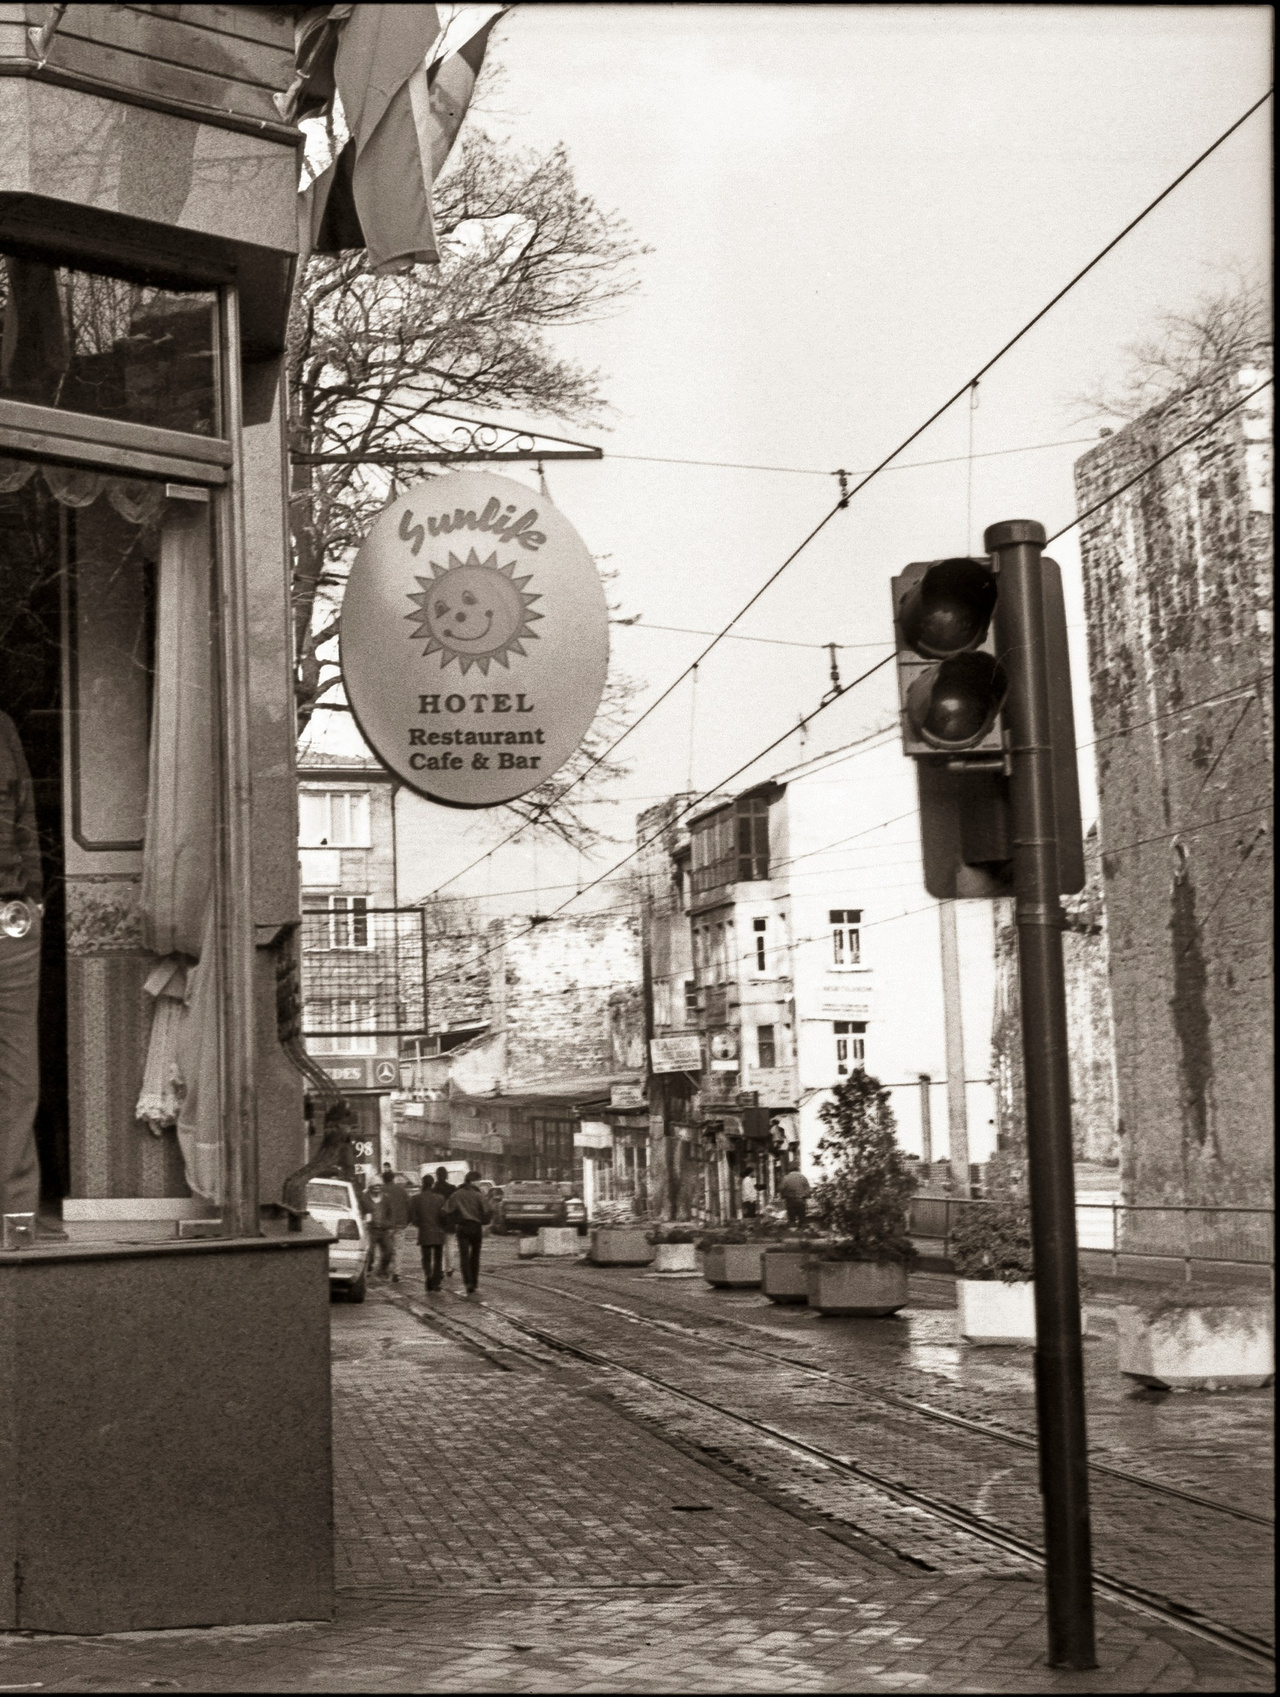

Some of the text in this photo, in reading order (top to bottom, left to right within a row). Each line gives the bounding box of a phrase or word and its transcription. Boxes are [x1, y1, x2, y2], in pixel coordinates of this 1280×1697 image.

[398, 496, 547, 557] Sunlife
[418, 693, 535, 714] HOTEL
[408, 728, 546, 746] Restaurant
[409, 752, 542, 771] Cafe & Bar
